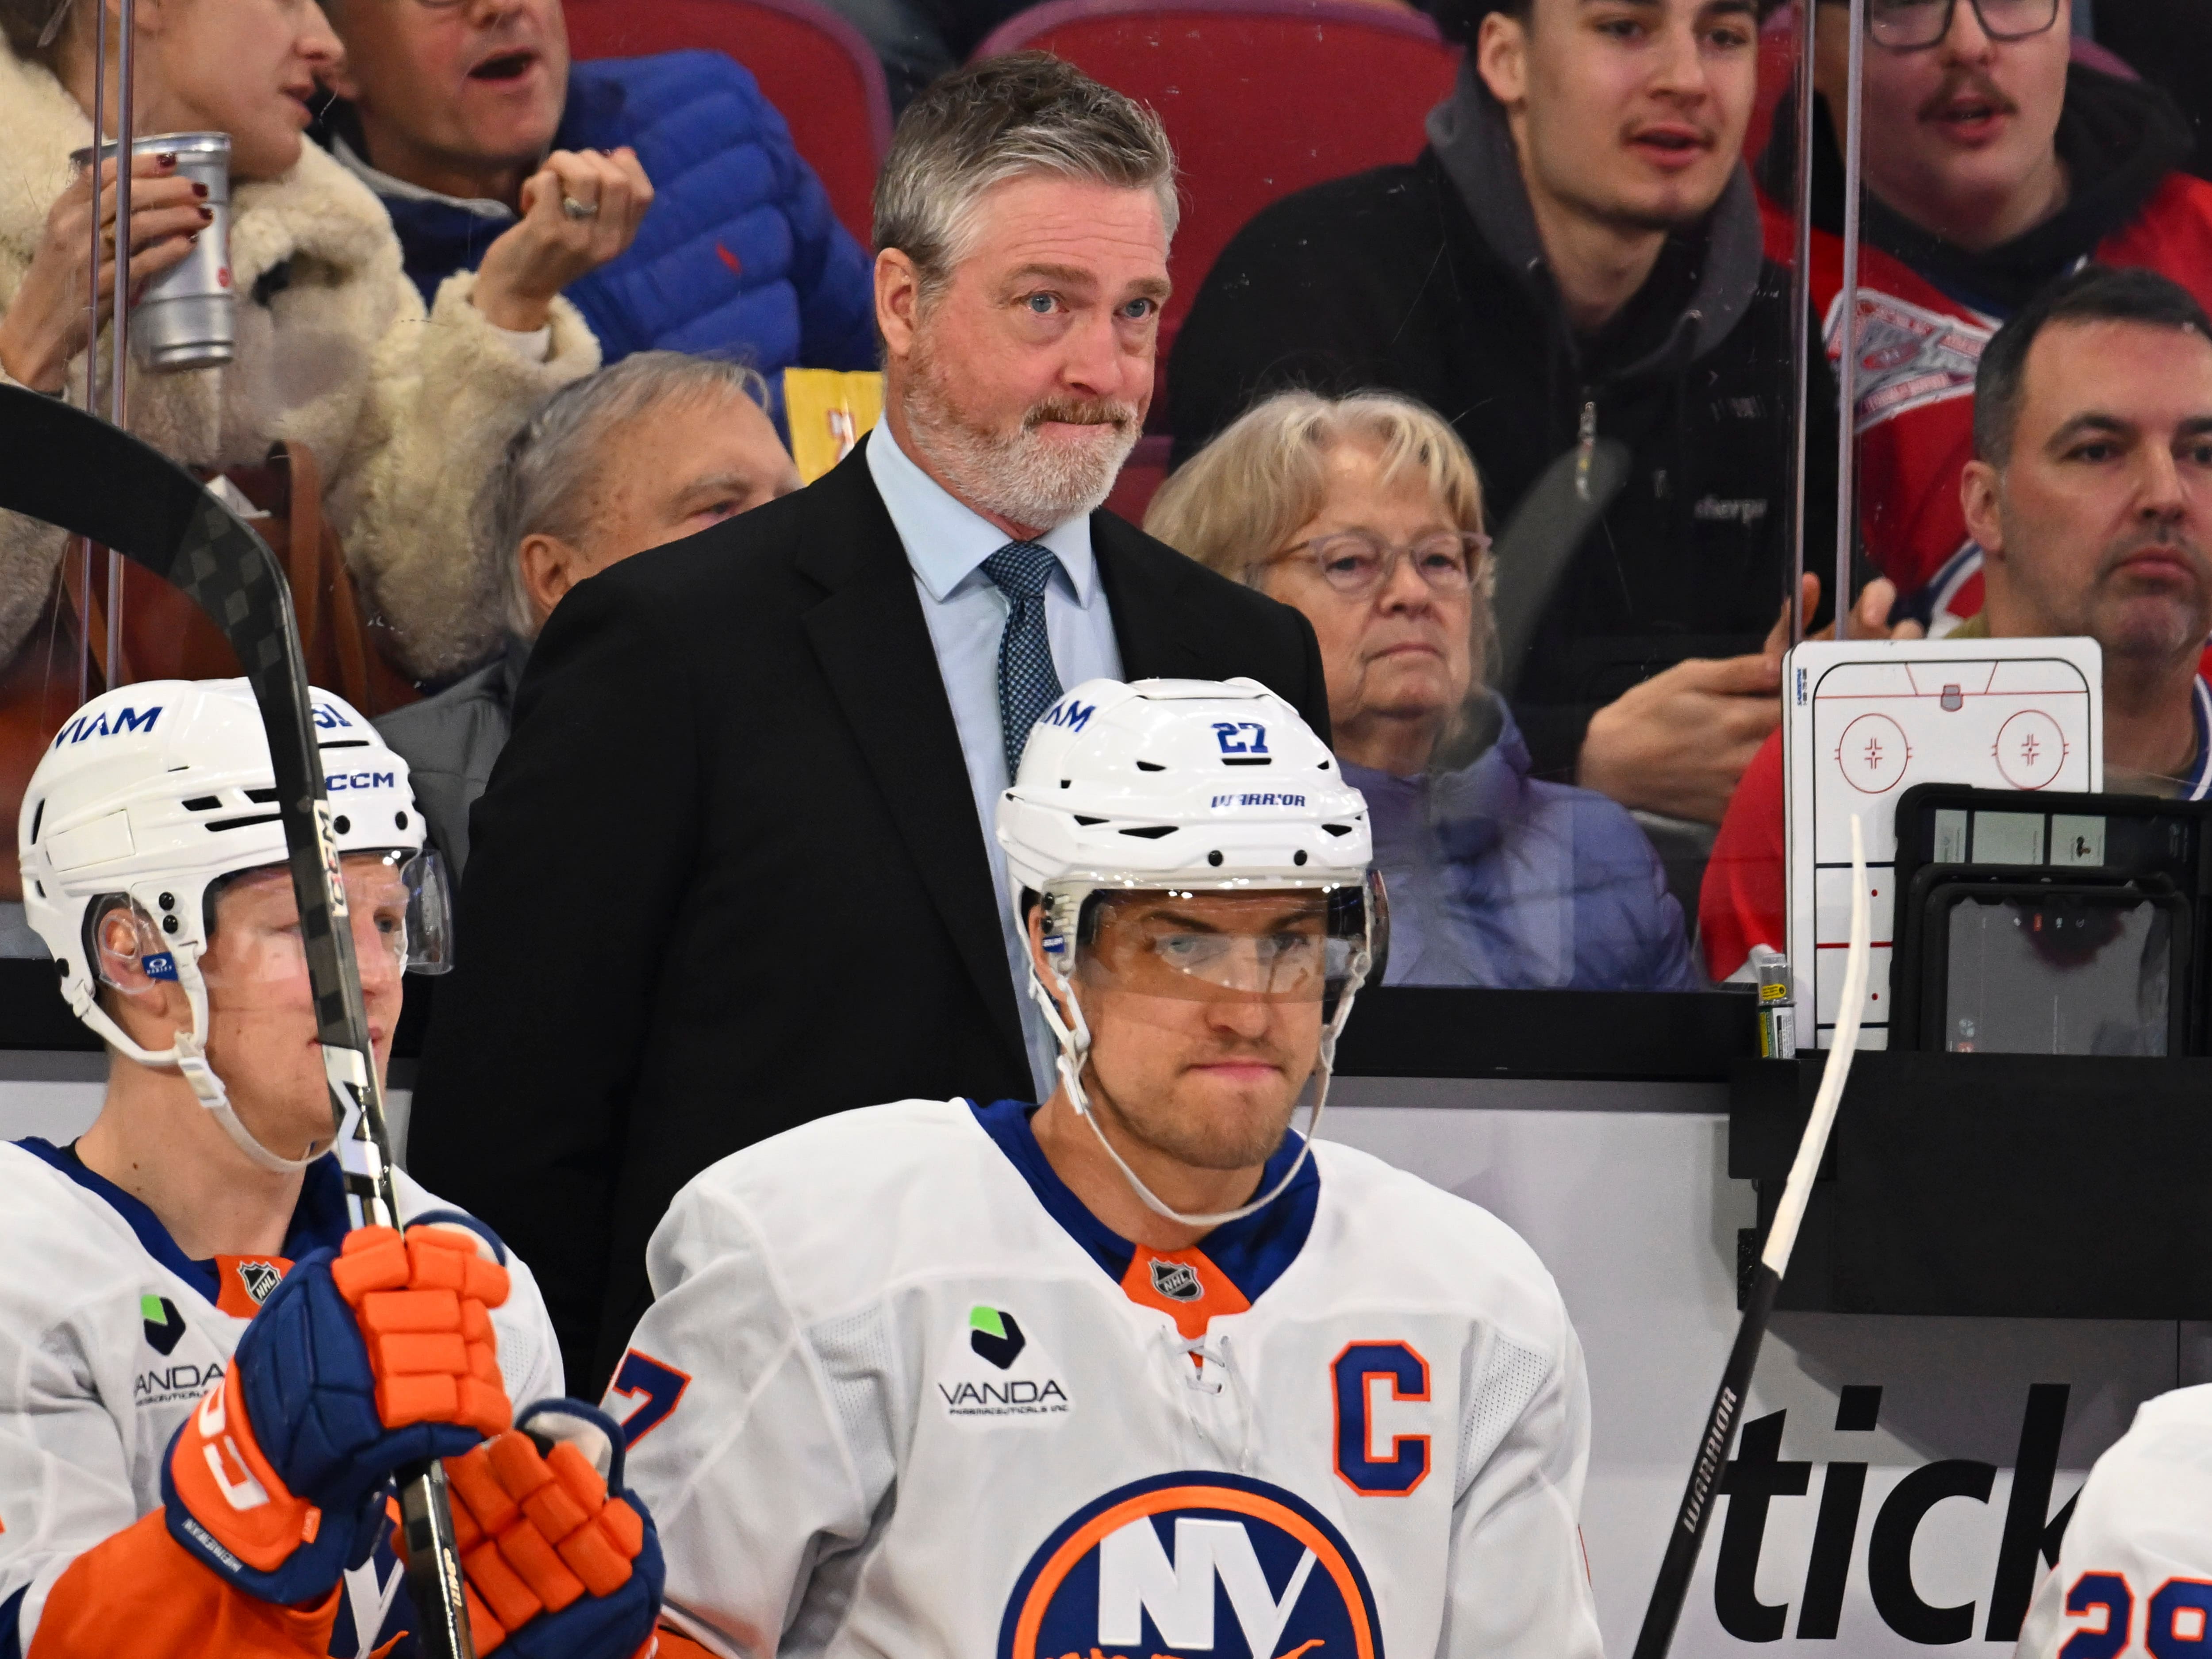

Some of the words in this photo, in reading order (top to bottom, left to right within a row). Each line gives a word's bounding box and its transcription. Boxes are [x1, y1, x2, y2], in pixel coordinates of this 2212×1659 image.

[55, 707, 163, 749] VIAM
[1043, 700, 1096, 732] AM
[1211, 722, 1269, 753] 27
[325, 772, 394, 791] CCM
[1211, 793, 1306, 808] WARRIOR
[256, 1275, 276, 1300] NHL
[1164, 1272, 1191, 1292] NHL
[133, 1363, 225, 1398] ANDA
[938, 1380, 1068, 1405] VANDA
[612, 1348, 692, 1453] 7
[1329, 1340, 1431, 1497] C
[1684, 1386, 1737, 1533] WARRIOR
[1098, 1515, 1317, 1659] NY
